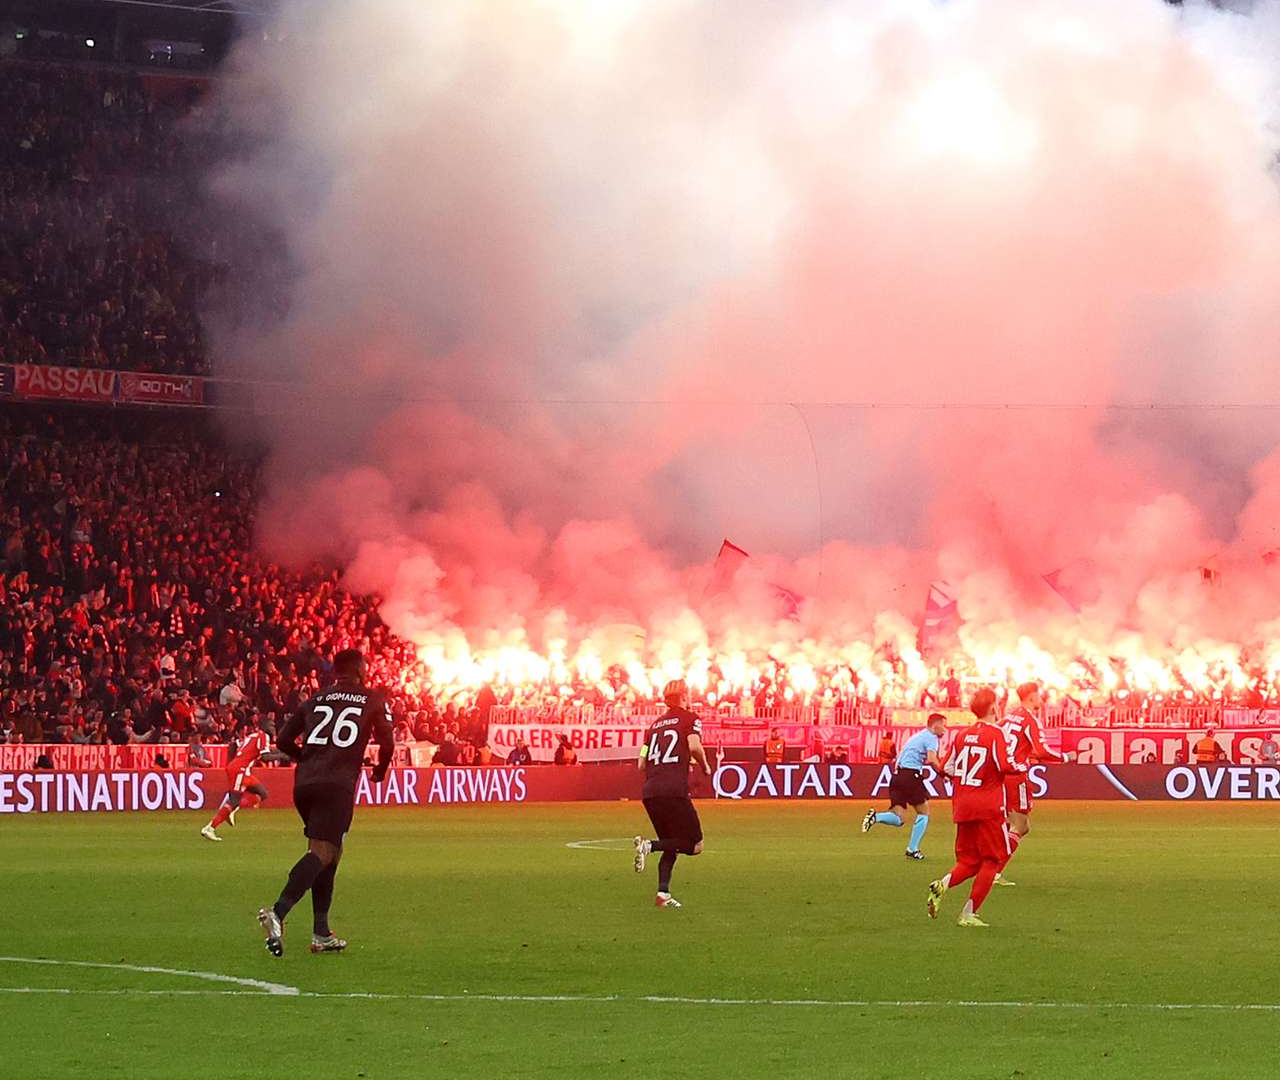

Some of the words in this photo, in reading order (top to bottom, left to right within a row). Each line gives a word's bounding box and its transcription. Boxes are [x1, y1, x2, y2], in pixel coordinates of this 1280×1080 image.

[15, 365, 115, 394] PASSAU
[307, 706, 362, 748] 26
[648, 729, 679, 766] 42
[713, 764, 853, 800] QATAR
[954, 746, 988, 787] 42
[1166, 766, 1280, 800] OVER
[429, 768, 527, 803] AIRWAYS
